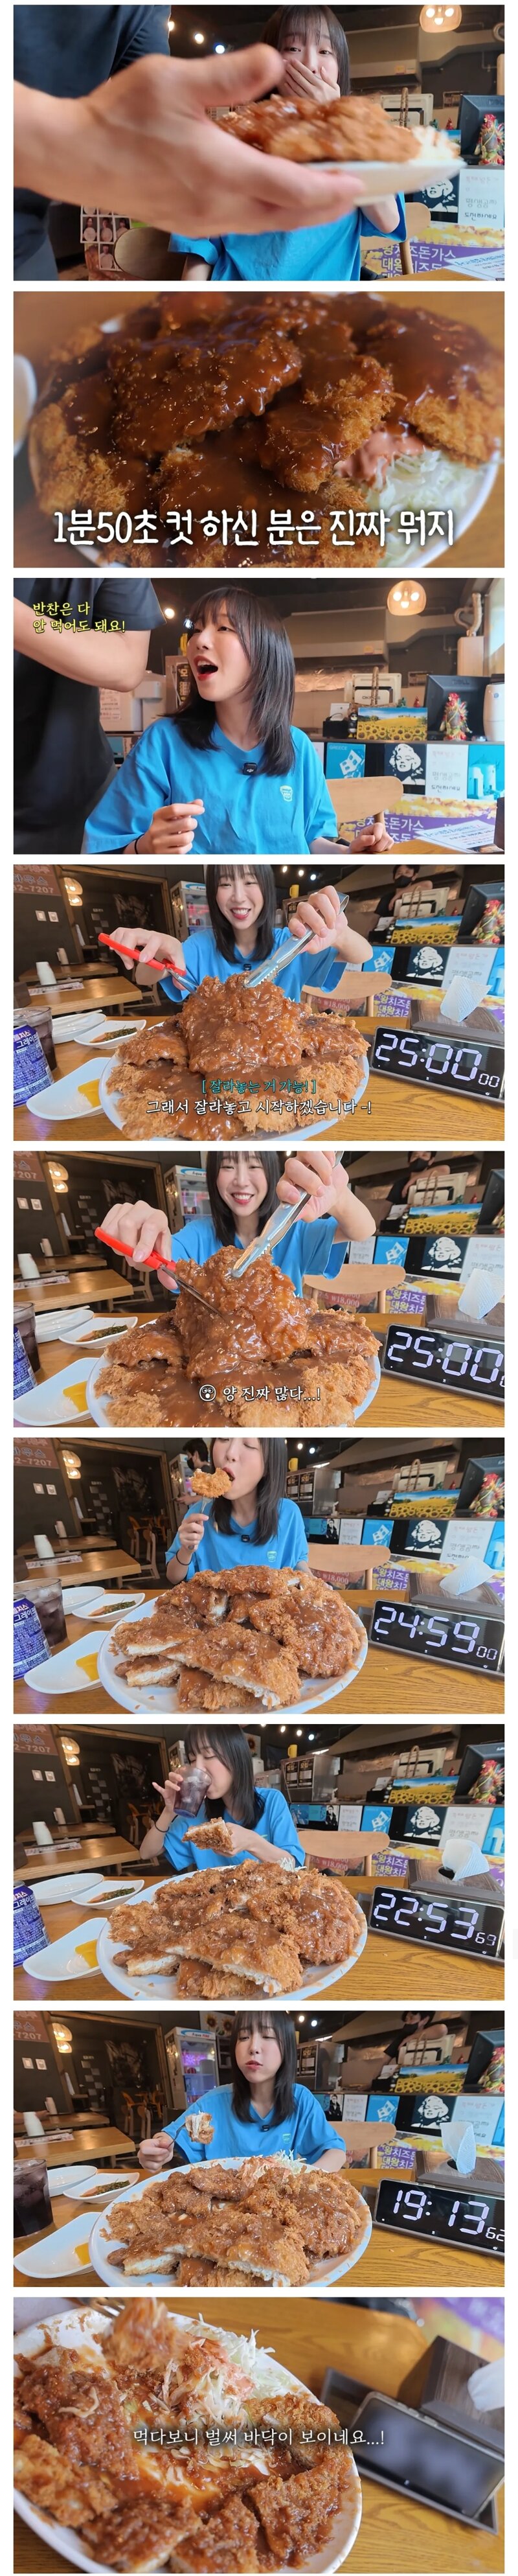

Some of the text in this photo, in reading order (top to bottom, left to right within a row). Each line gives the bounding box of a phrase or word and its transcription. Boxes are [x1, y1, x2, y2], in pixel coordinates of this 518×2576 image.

[376, 1033, 501, 1088] 25:00 00
[387, 1331, 504, 1383] 25:00
[374, 1606, 498, 1660] 24:59 00
[374, 1892, 479, 1940] 22:53
[393, 2189, 490, 2235] 19:13
